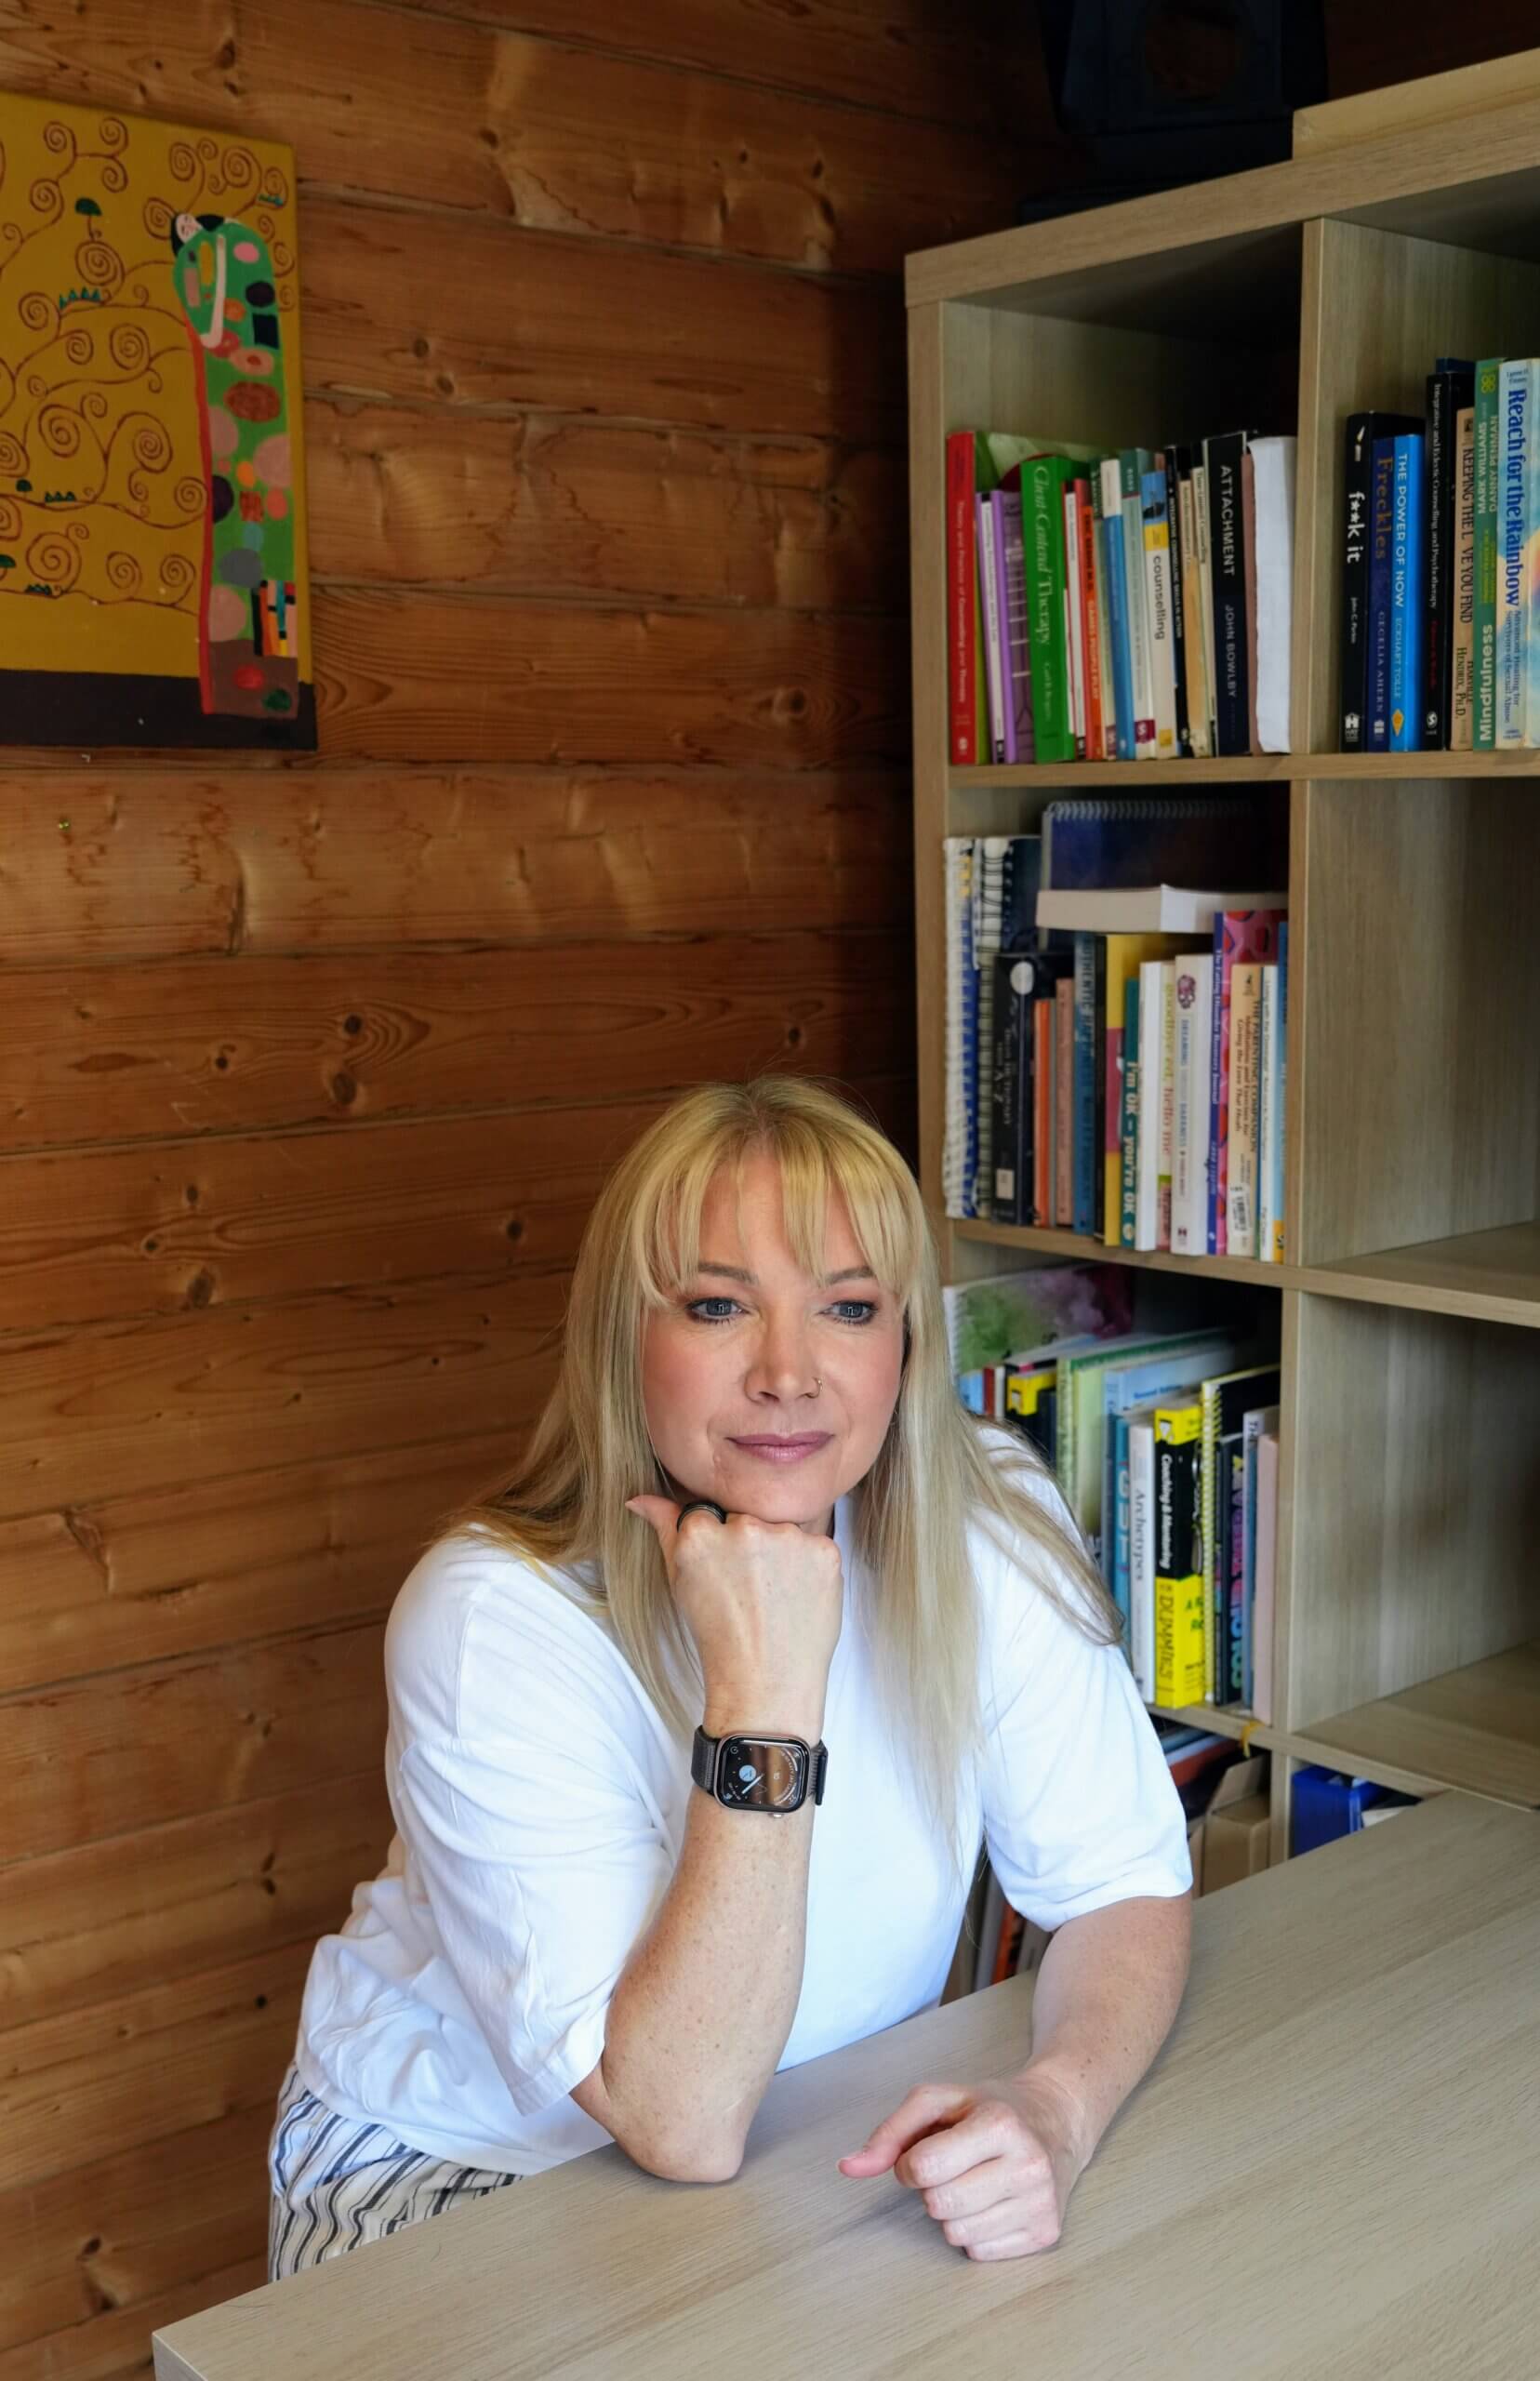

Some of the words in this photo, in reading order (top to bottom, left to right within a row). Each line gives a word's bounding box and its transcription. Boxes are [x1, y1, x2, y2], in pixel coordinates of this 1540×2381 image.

[1432, 383, 1442, 430] Integrative
[1507, 389, 1528, 452] Reach
[1431, 448, 1441, 477] Eclectic
[1432, 431, 1441, 446] and
[1478, 422, 1488, 476] WILLIAMS
[1489, 415, 1499, 467] PENMAN
[1397, 453, 1408, 481] THE
[1461, 447, 1474, 504] KEEPING
[1507, 454, 1526, 483] for
[1375, 456, 1394, 559] Freckles
[1396, 486, 1408, 541] POWER
[1430, 479, 1441, 529] Counselling
[1478, 479, 1488, 514] MARK
[1488, 470, 1498, 513] DANNY
[1507, 486, 1525, 517] the
[1220, 465, 1235, 576] ATTACHMENT
[1431, 531, 1440, 547] and
[1461, 506, 1474, 528] THE
[1346, 545, 1364, 564] it
[1395, 546, 1406, 565] OF
[1505, 519, 1525, 607] Rainbow
[1153, 555, 1169, 641] counselling
[1394, 570, 1405, 608] NOW
[1429, 549, 1440, 610] Psychotherapy
[1460, 567, 1473, 593] YOU
[957, 597, 968, 648] Counselling
[1034, 576, 1055, 645] Therapy
[1224, 604, 1236, 640] JOHN
[1459, 595, 1473, 624] FIND
[1375, 610, 1386, 667] CECELIA
[1393, 617, 1403, 665] ECKHART
[1226, 643, 1238, 698] BOWLBY
[1375, 669, 1386, 713] AHERN
[1393, 667, 1402, 699] TOLLE
[1479, 624, 1494, 742] Mindfulness
[1125, 1092, 1138, 1116] OK
[1122, 1136, 1135, 1189] you're
[1122, 1191, 1135, 1216] OK
[1159, 1453, 1174, 1504] Coaching
[1162, 1504, 1172, 1515] &
[1135, 1488, 1149, 1581] Archetypes
[1159, 1515, 1173, 1570] Mentoring
[1159, 1593, 1175, 1681] DUMMIES
